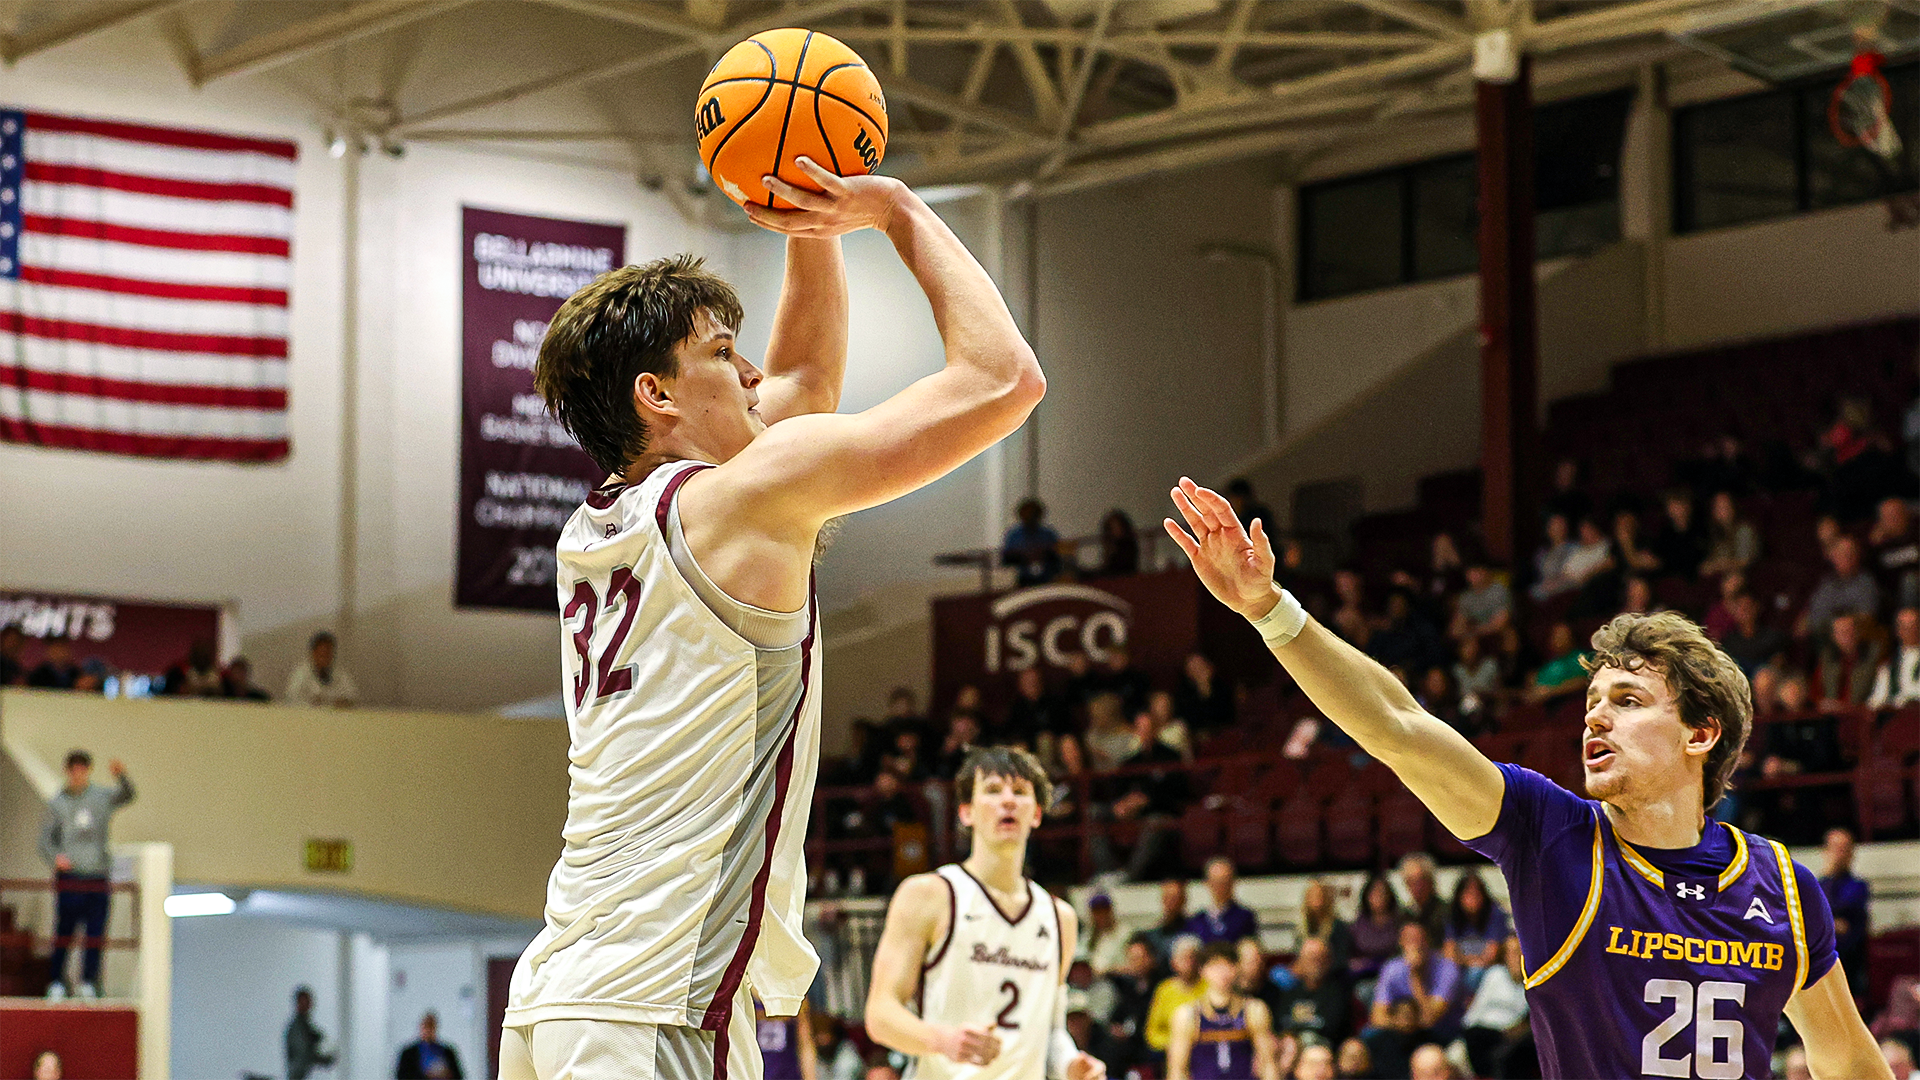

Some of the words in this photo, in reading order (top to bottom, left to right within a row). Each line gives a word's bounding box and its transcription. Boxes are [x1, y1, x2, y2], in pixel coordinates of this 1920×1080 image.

[563, 563, 645, 717] 32
[1605, 926, 1785, 971] LIPSCOMB
[996, 980, 1021, 1029] 2
[1641, 978, 1746, 1080] 26
